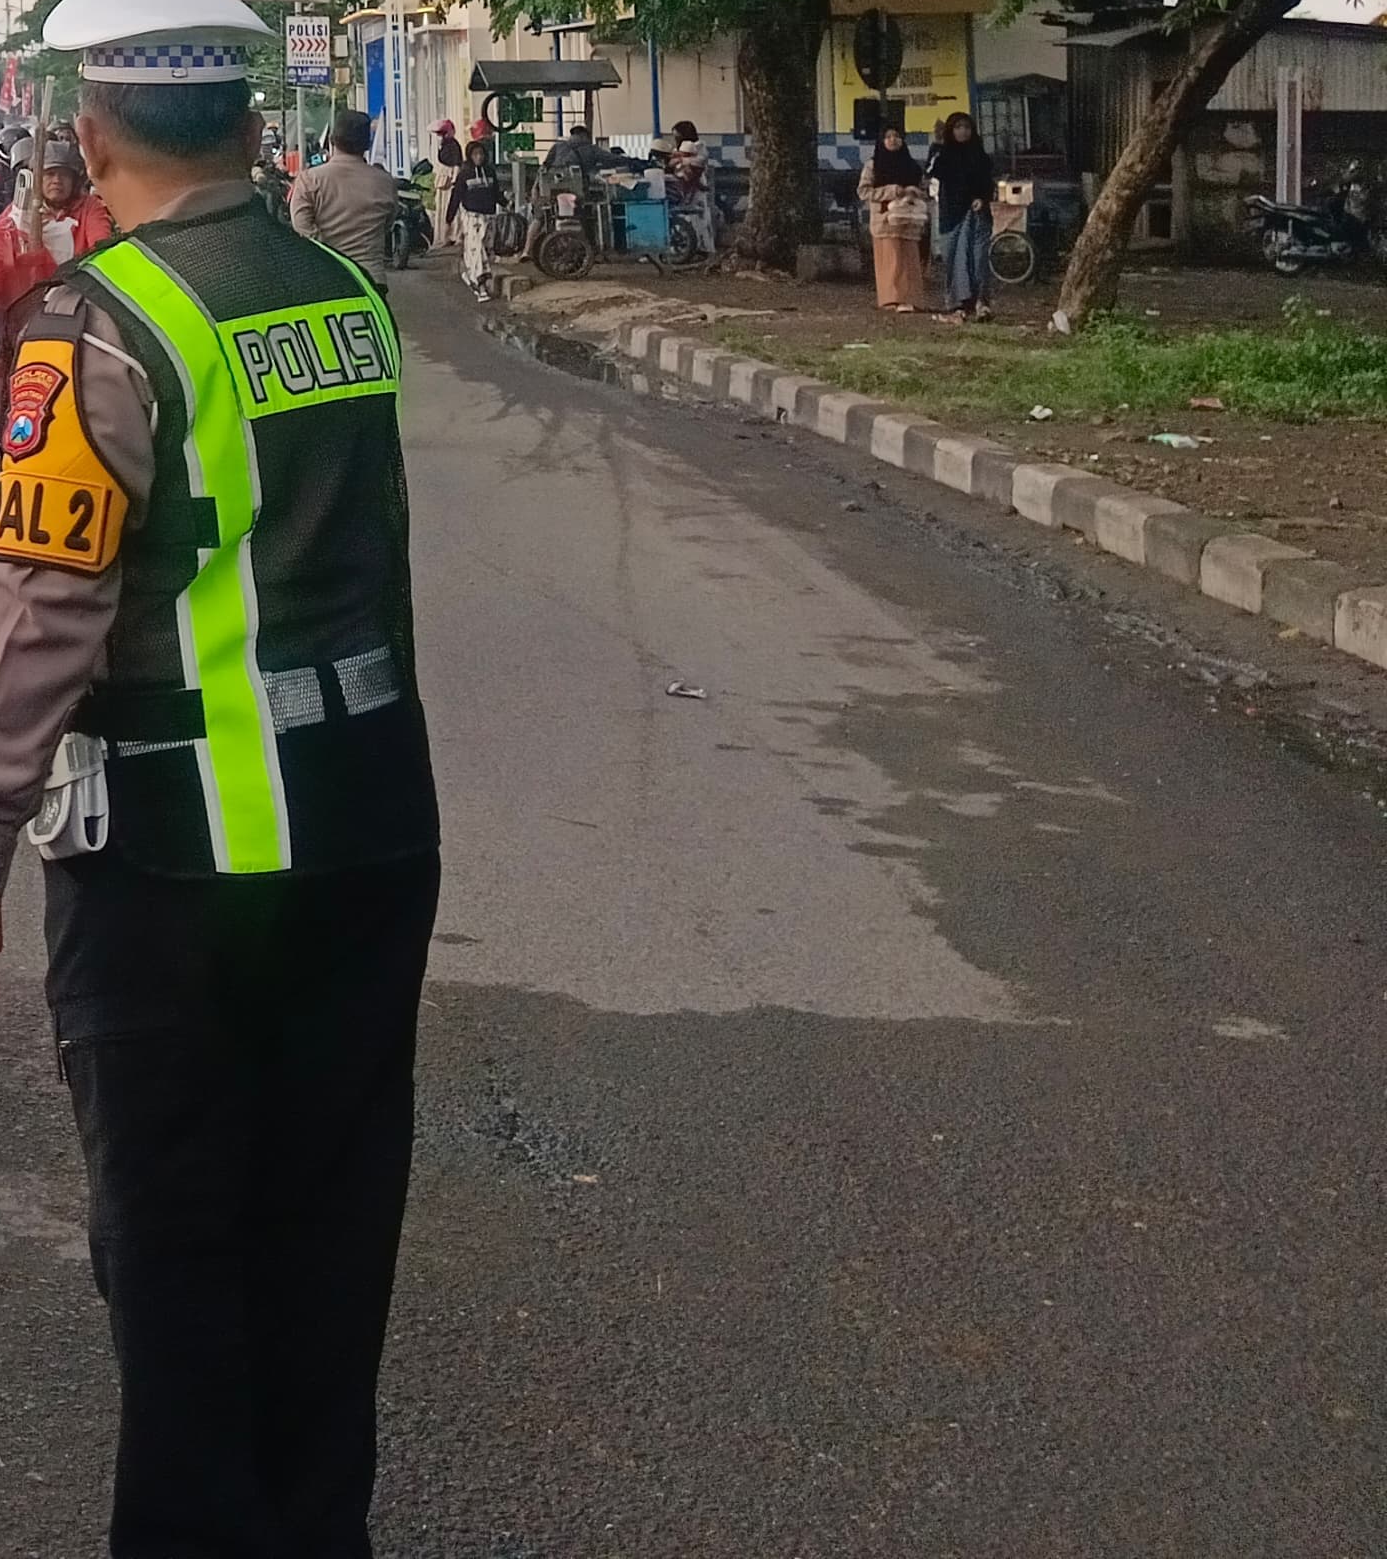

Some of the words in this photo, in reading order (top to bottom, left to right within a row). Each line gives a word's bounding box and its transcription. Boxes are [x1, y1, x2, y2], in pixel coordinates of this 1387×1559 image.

[289, 24, 328, 36] POLISI
[233, 310, 395, 404] POLISI
[64, 489, 95, 552] 2
